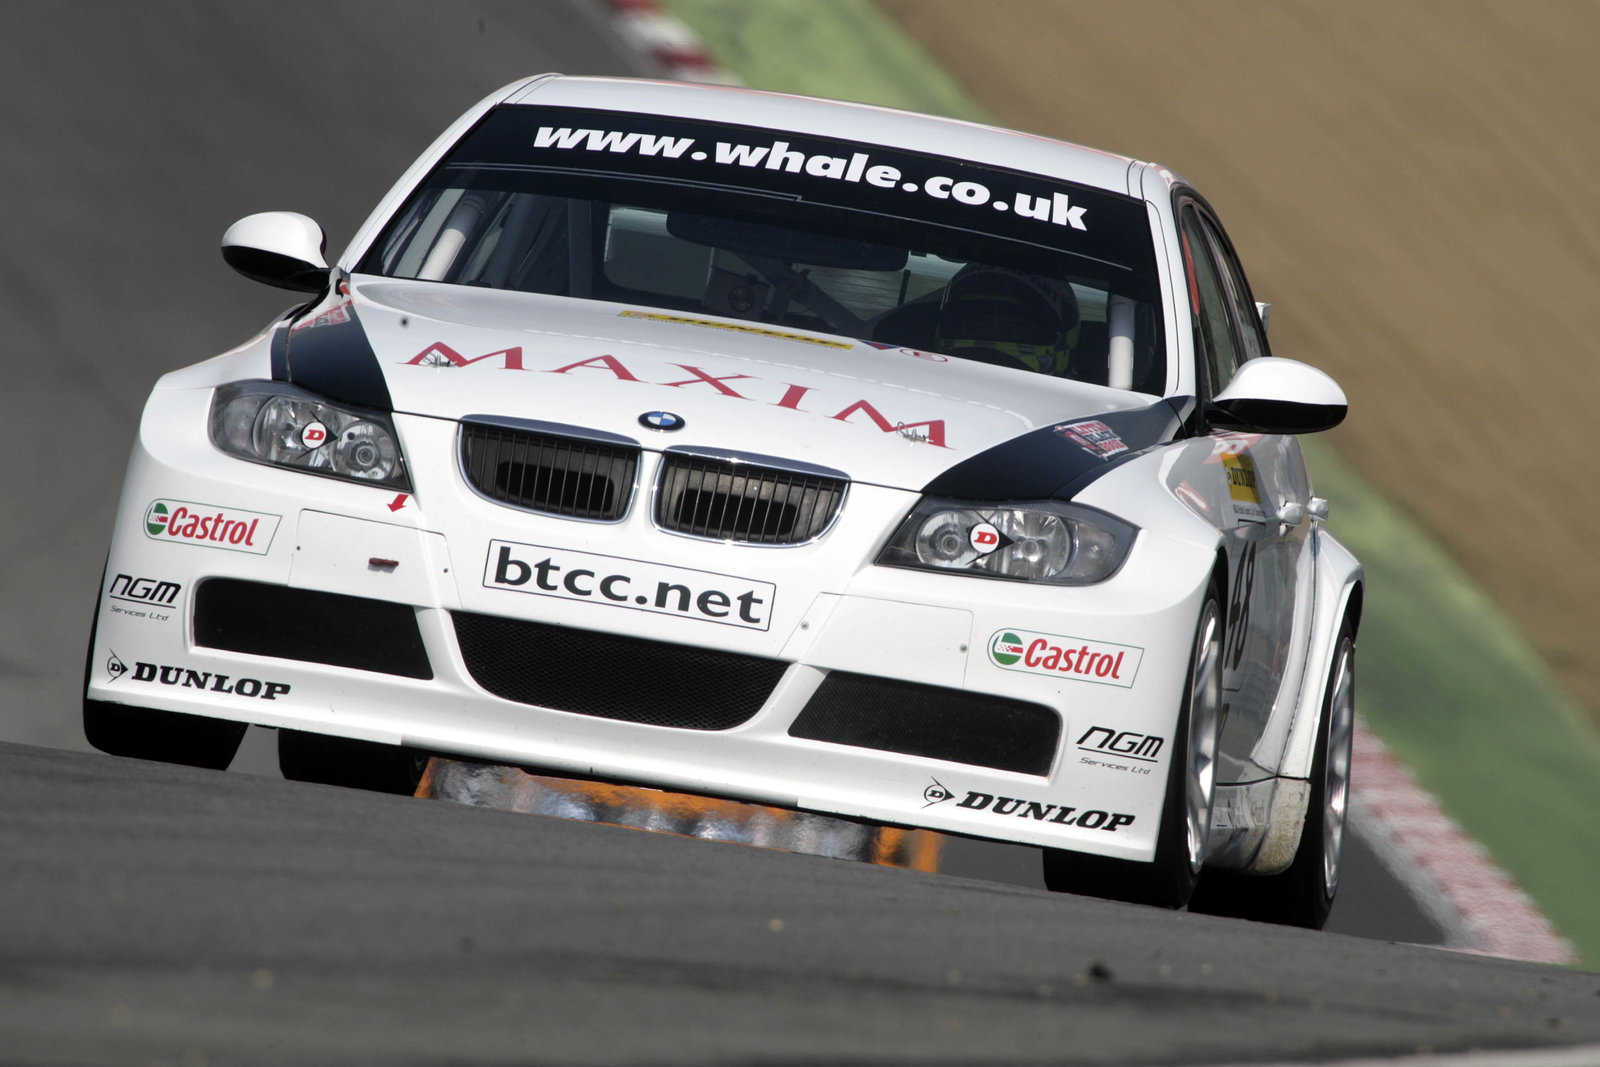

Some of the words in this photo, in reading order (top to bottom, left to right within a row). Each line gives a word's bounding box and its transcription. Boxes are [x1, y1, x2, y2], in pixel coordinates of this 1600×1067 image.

[533, 125, 1088, 232] www.whale.co.uk
[397, 341, 956, 450] MAXIM
[167, 506, 260, 547] Castrol
[494, 546, 764, 624] btcc.net
[110, 604, 147, 619] Services
[149, 611, 170, 622] Ltd
[1024, 638, 1126, 680] Castrol
[131, 661, 291, 700] DUNLOP
[1079, 757, 1130, 772] Services
[1131, 765, 1151, 776] Ltd
[956, 790, 1136, 832] DUNLOP
